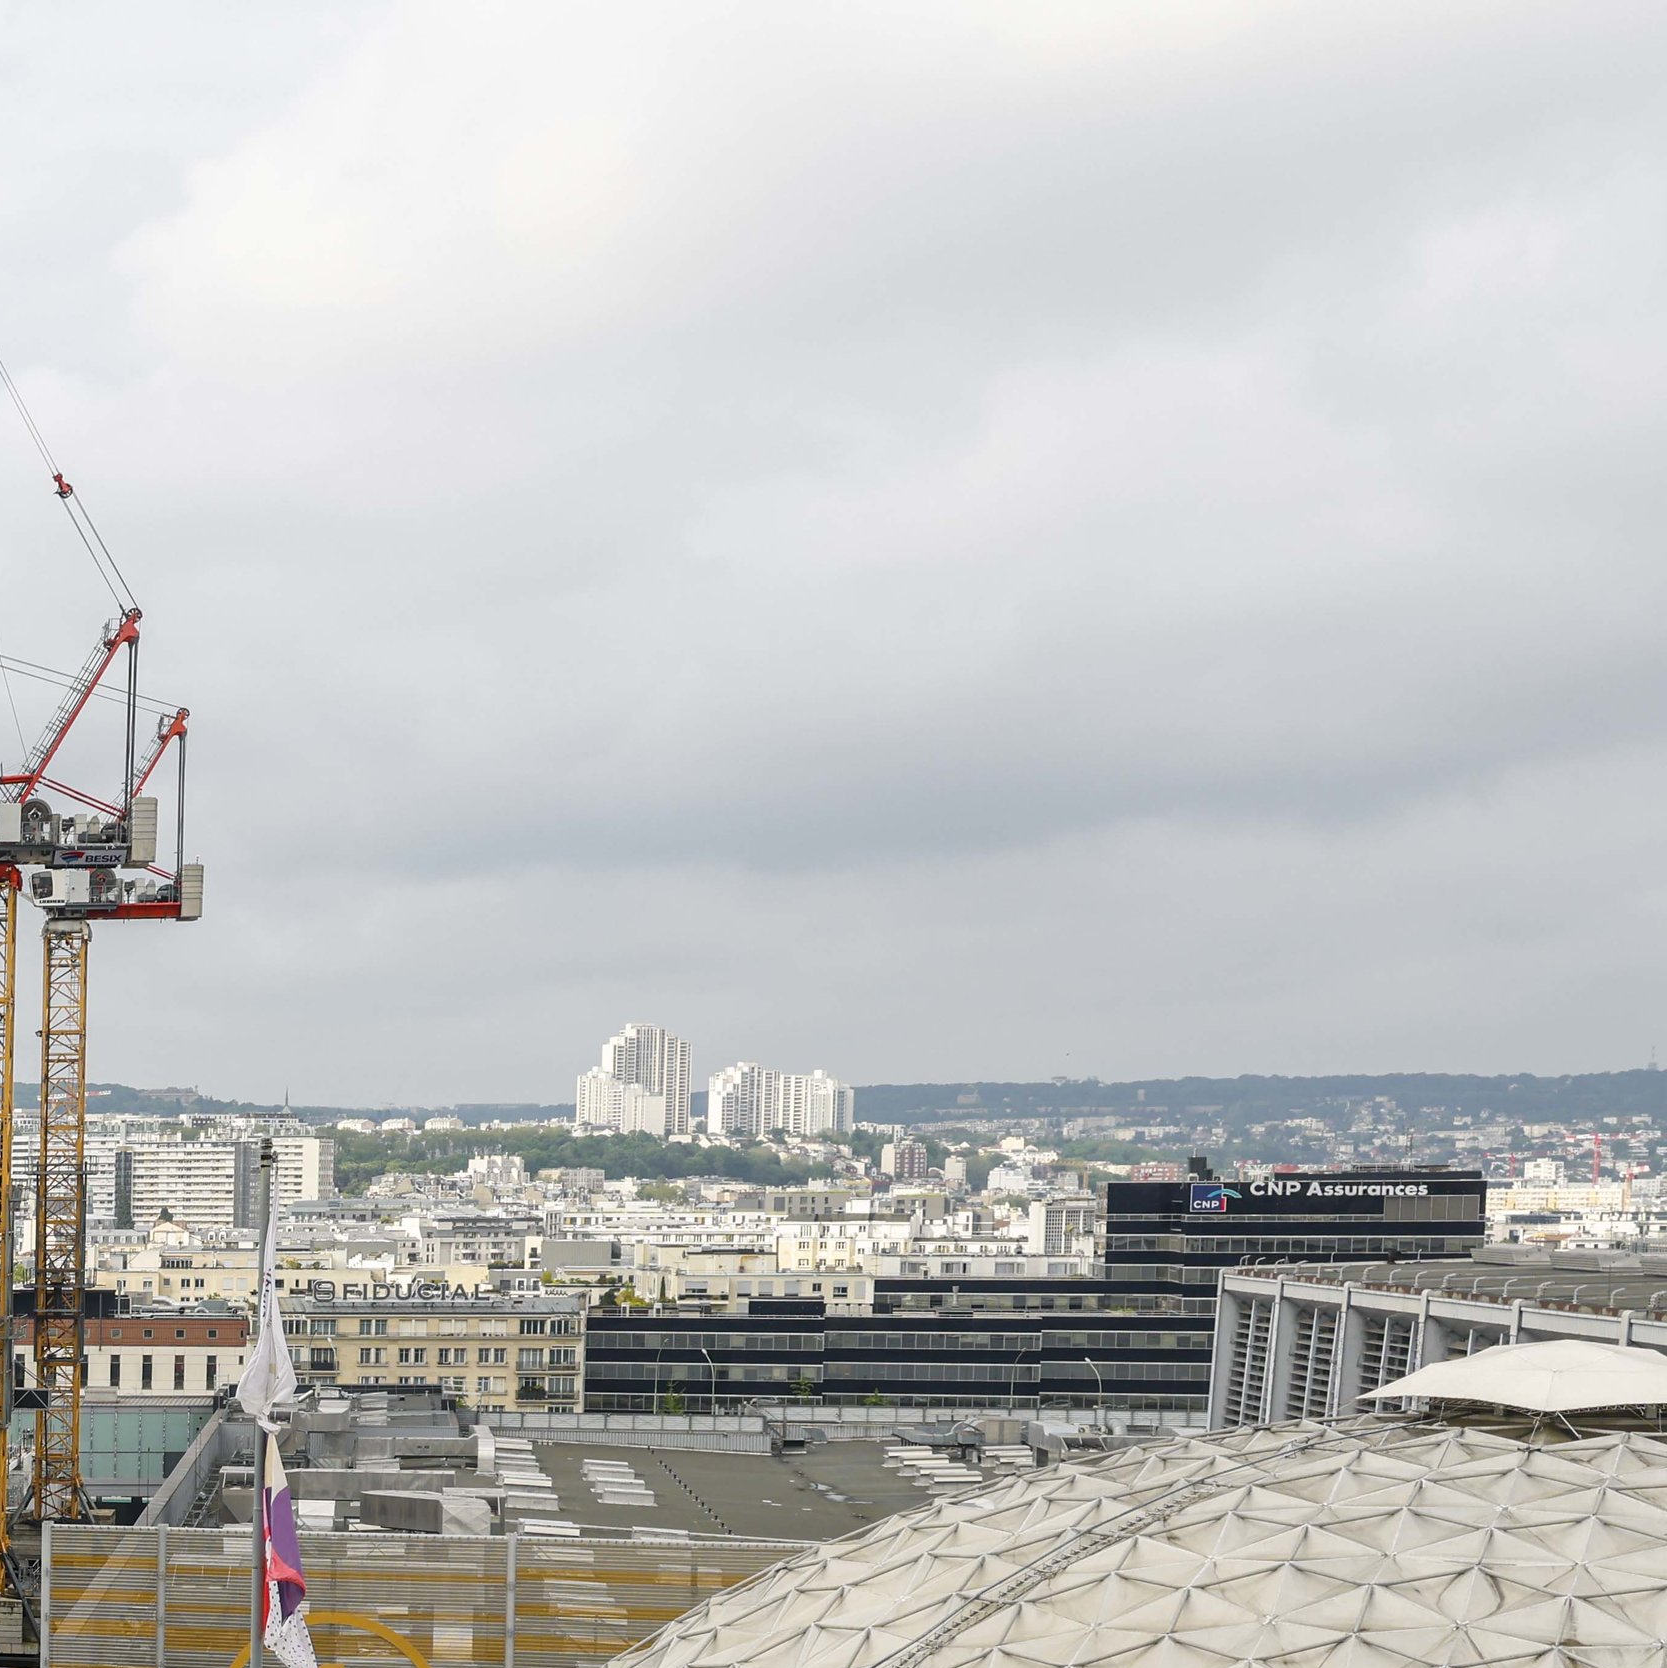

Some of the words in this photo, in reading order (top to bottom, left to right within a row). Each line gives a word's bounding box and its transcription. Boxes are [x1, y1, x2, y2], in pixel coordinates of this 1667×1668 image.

[85, 854, 123, 863] BESIX
[1250, 1181, 1301, 1196] CNP
[1306, 1182, 1428, 1196] Assurances
[1193, 1200, 1219, 1209] CNP
